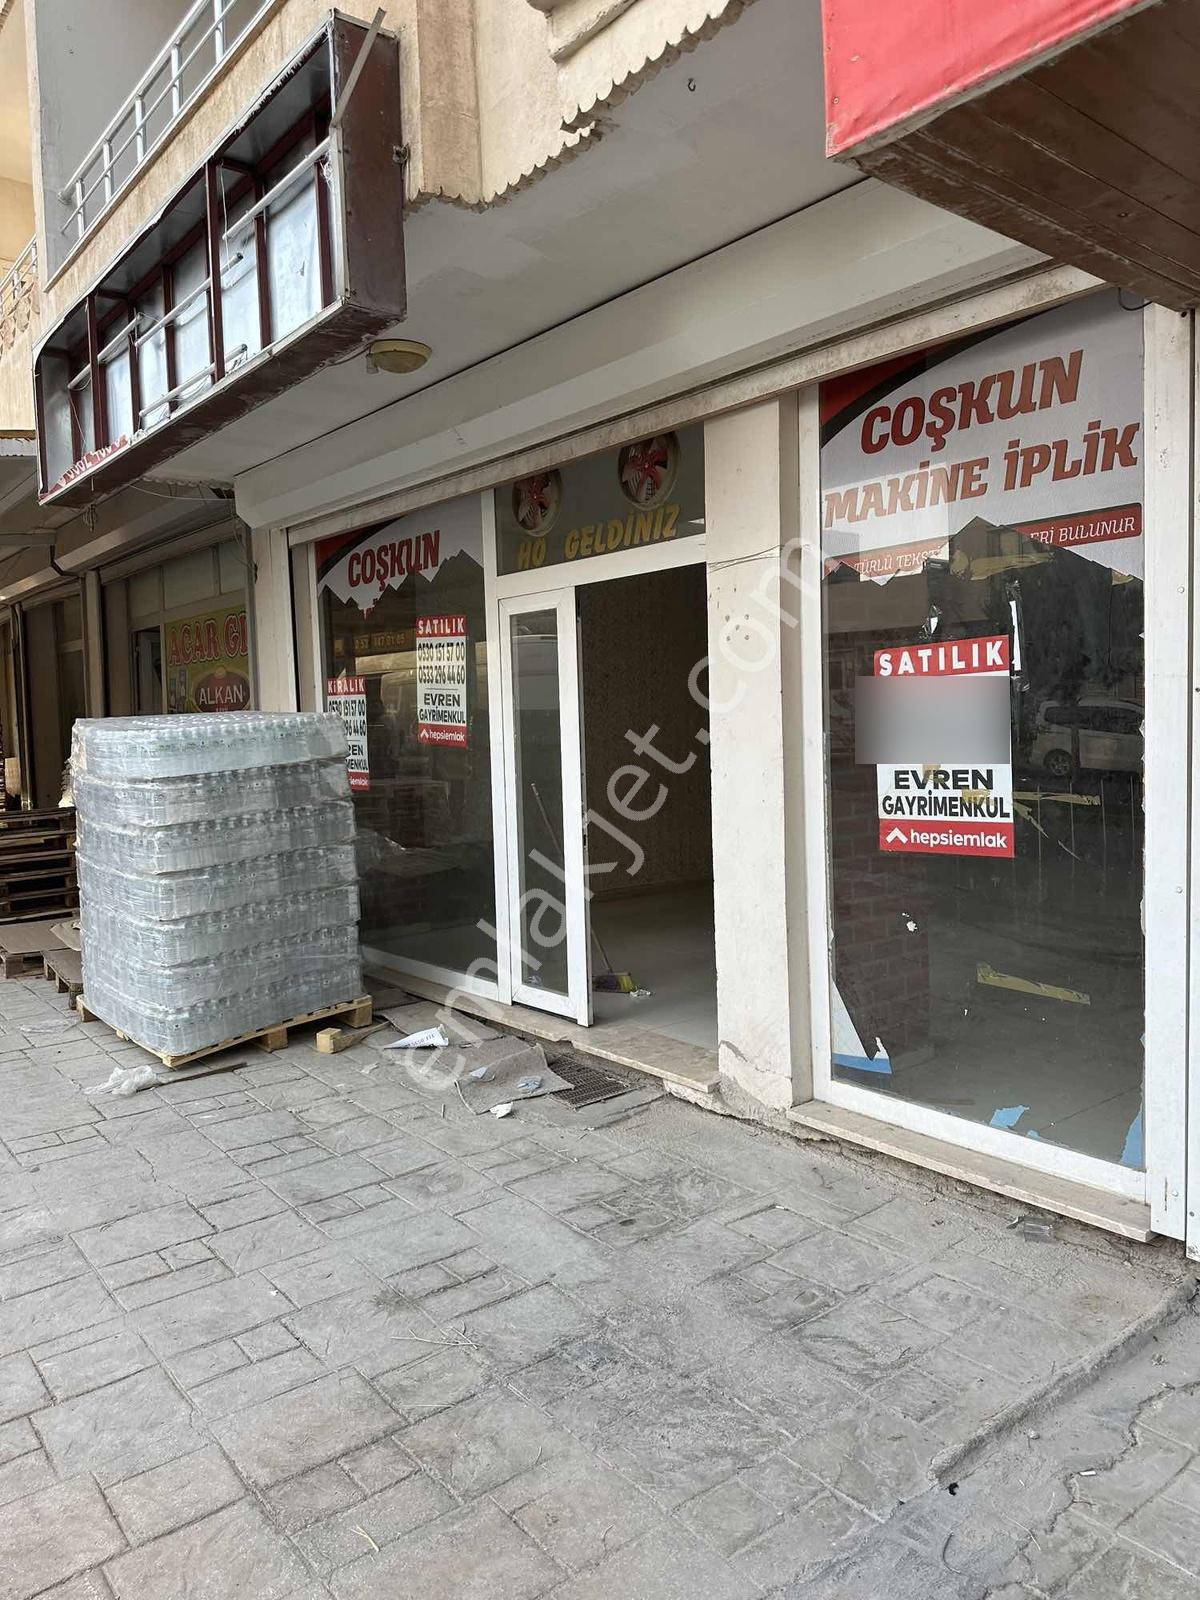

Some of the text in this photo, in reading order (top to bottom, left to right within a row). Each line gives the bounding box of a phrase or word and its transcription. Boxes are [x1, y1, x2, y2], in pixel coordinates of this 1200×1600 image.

[861, 349, 1083, 454] COŞKUN
[825, 420, 1140, 529] MAKİNE İPLİK
[1059, 517, 1136, 542] BULUNUR
[347, 530, 441, 592] COŞKUN
[418, 617, 464, 635] SATILIK
[418, 642, 465, 662] 0530 151 57 00
[879, 640, 1004, 676] SATILIK
[418, 665, 465, 684] 0533 296 44 60
[199, 684, 244, 705] ALKAN
[328, 678, 365, 694] KİRALIK
[359, 699, 365, 716] 00
[423, 693, 461, 707] EVREN
[419, 706, 466, 724] GAYRİMENKUL
[429, 728, 465, 743] hepsiemlak
[894, 769, 994, 790] EVREN
[882, 790, 1010, 818] GAYRİMENKUL
[910, 828, 1008, 849] hepsiemlak
